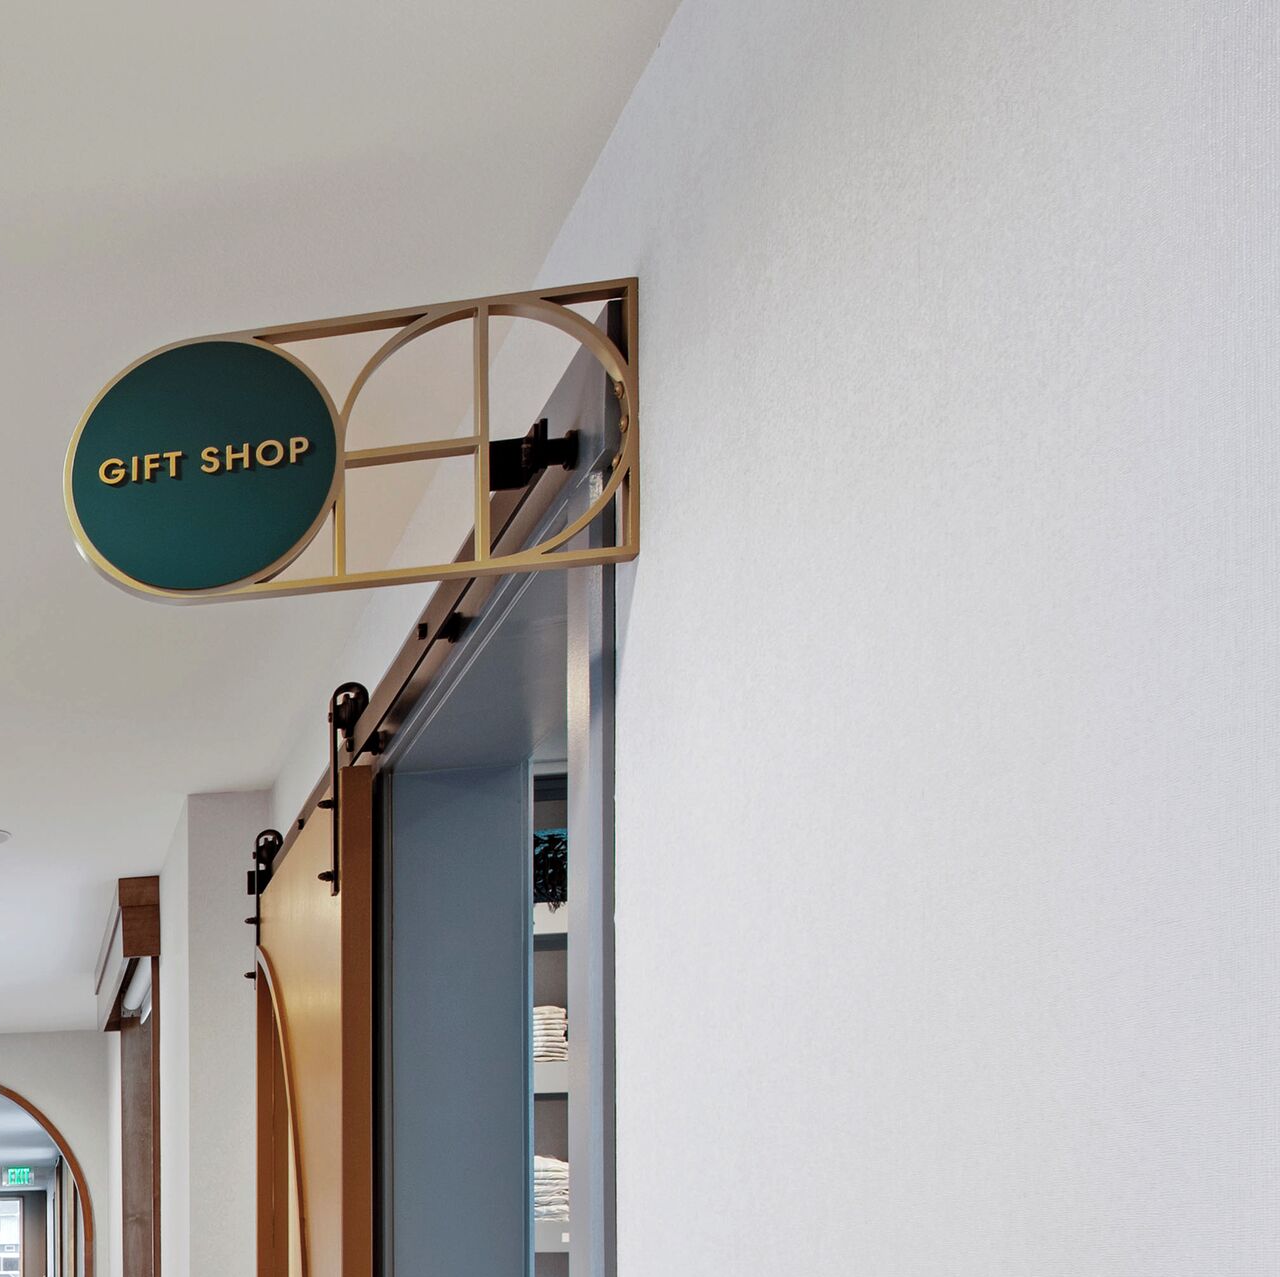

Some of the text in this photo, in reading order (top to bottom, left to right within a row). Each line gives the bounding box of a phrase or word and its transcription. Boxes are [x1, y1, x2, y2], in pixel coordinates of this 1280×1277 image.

[98, 436, 310, 485] GIFT SHOP
[7, 1168, 29, 1184] EXIT
